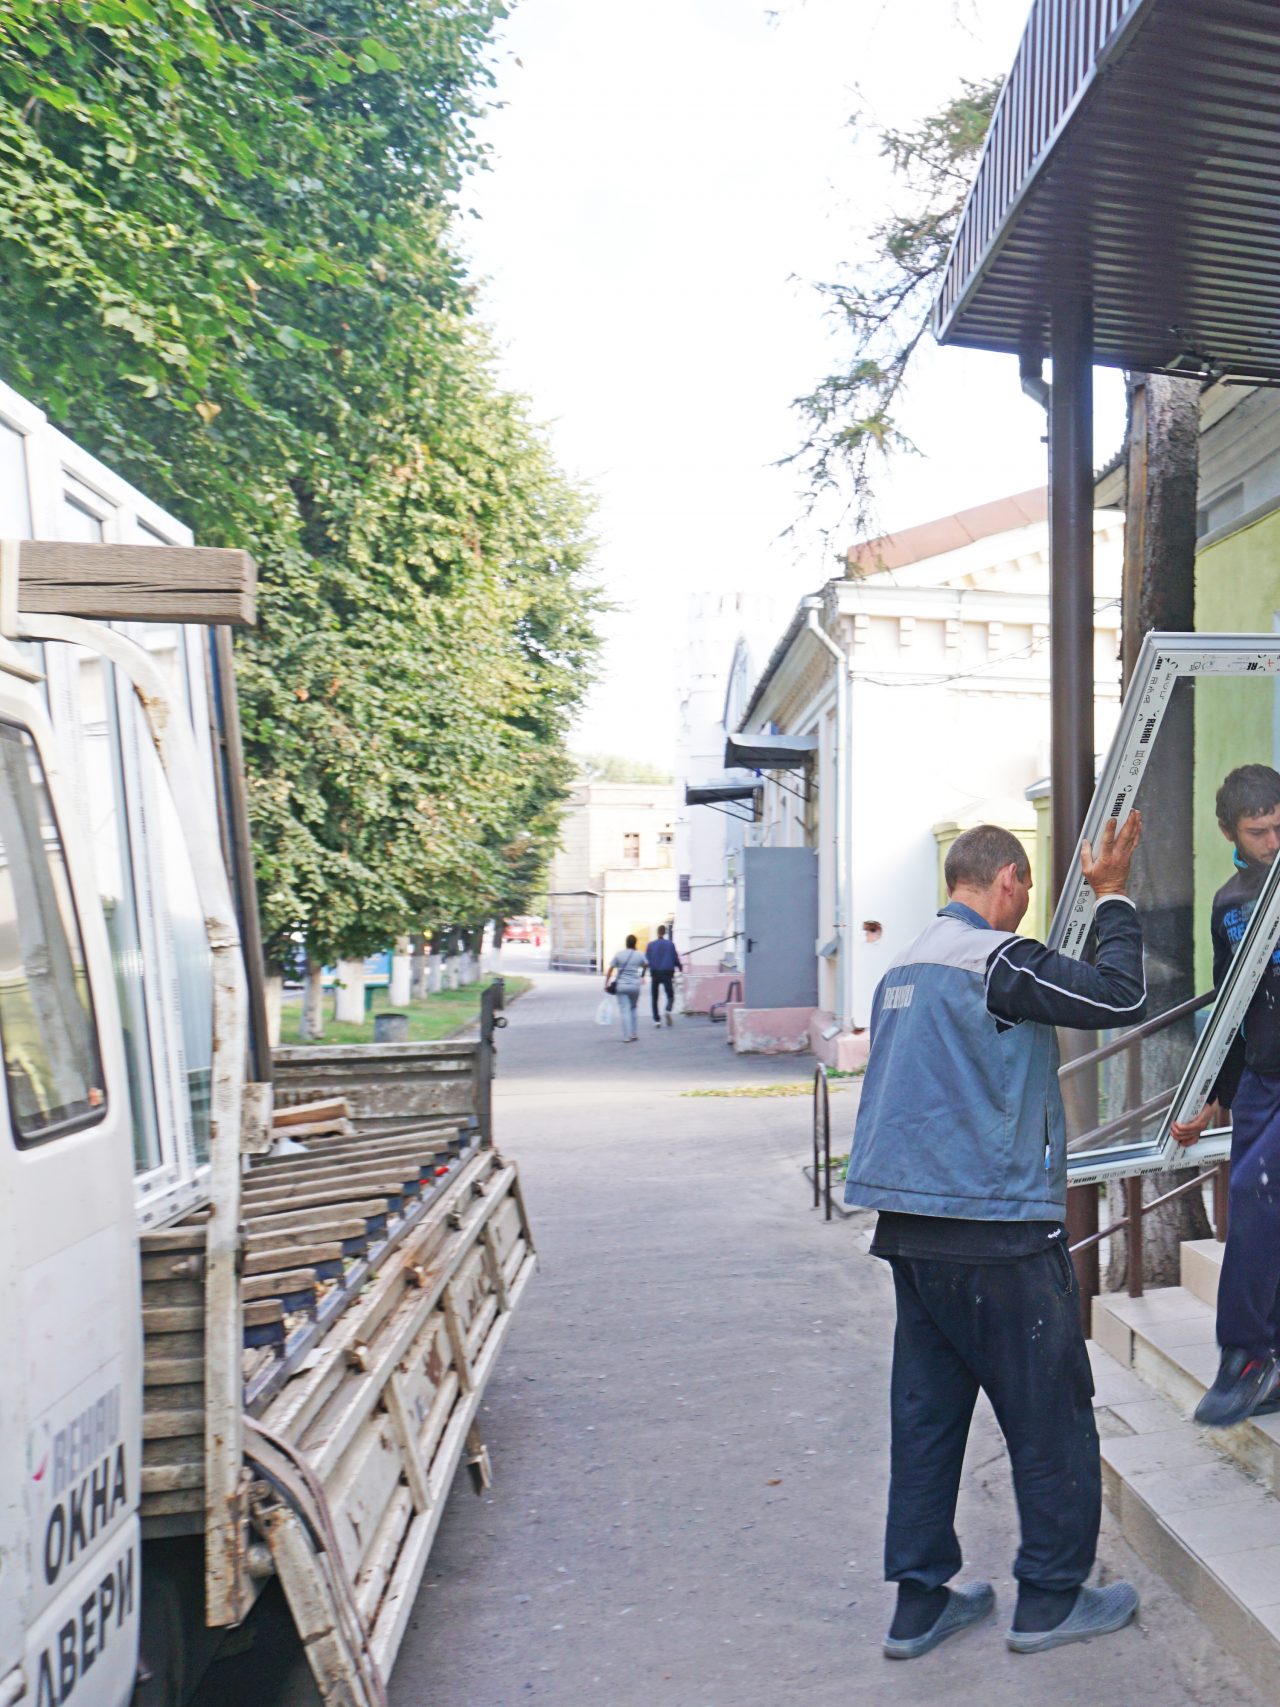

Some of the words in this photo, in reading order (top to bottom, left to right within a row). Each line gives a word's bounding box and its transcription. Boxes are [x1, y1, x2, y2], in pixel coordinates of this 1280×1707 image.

[1140, 718, 1157, 744] REHAU
[1111, 793, 1127, 817] REHAU
[44, 1442, 127, 1586] ОКНА
